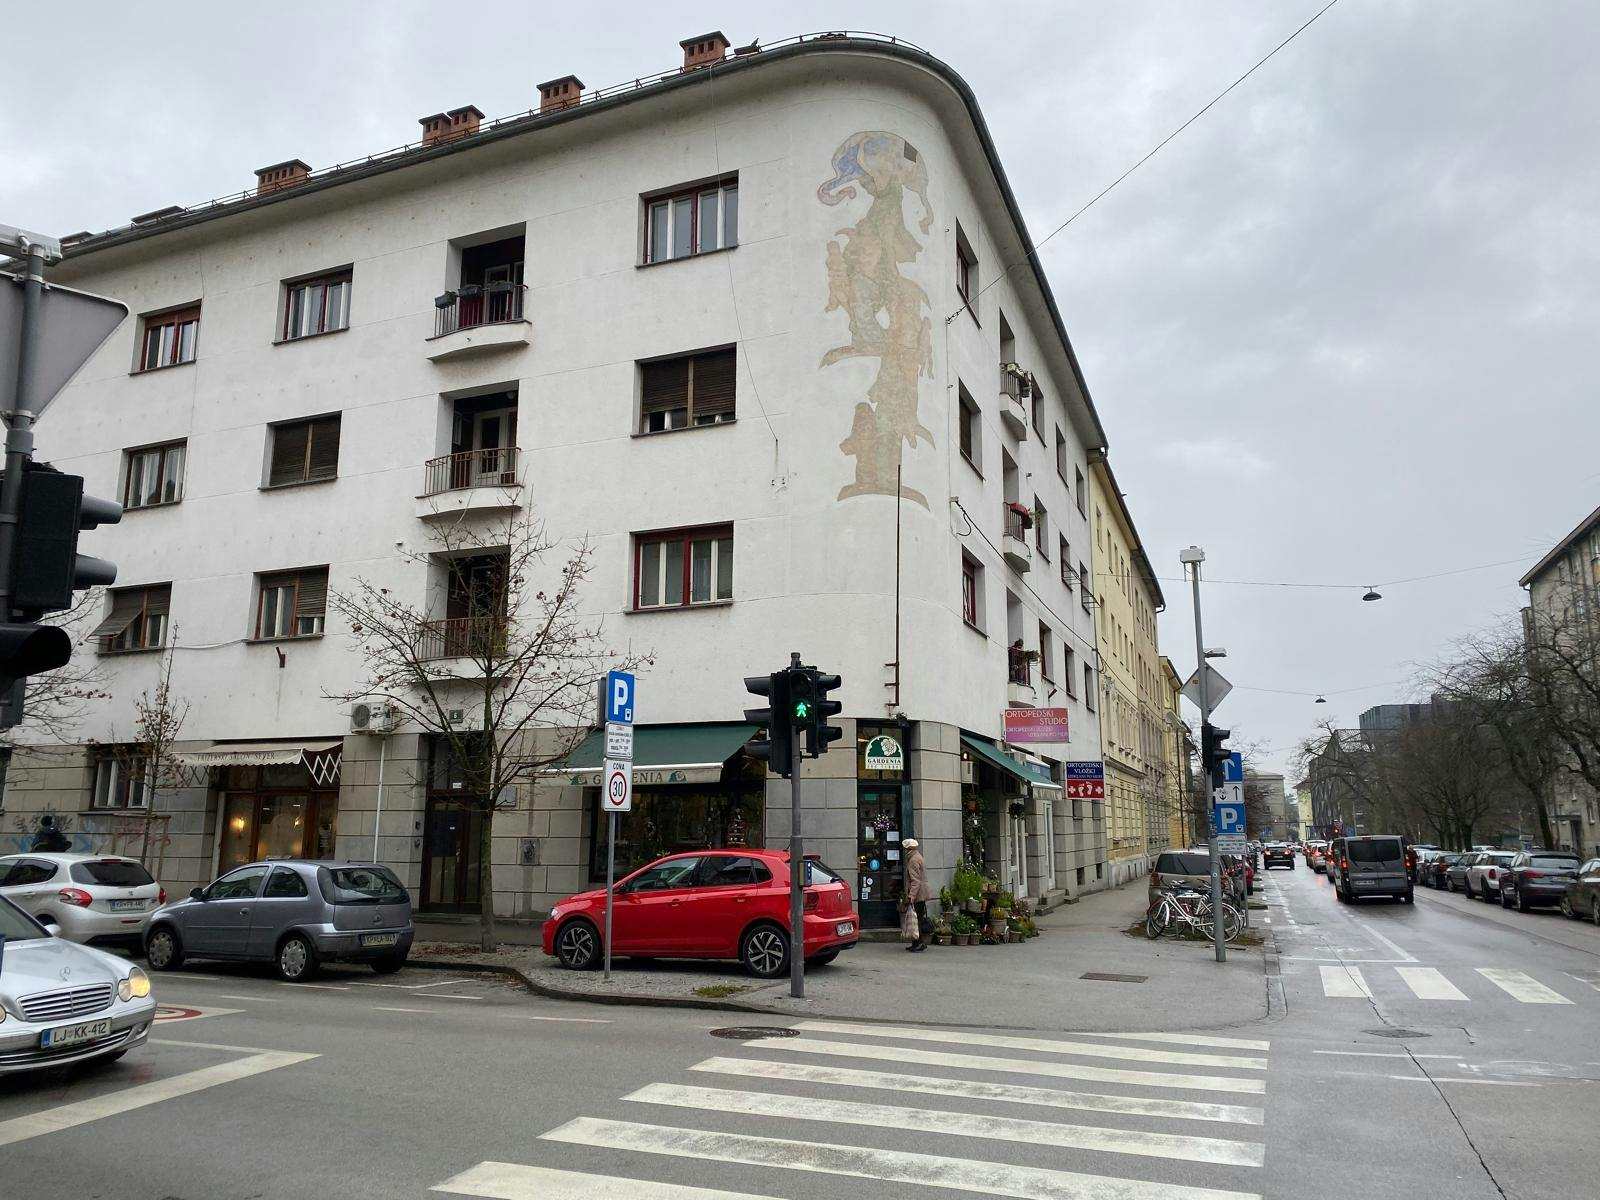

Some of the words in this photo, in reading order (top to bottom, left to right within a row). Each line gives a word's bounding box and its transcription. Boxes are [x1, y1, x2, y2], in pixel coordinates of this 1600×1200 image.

[613, 678, 628, 715] P
[1005, 709, 1054, 718] ORTOPEDSKI
[1039, 717, 1068, 725] STUDIO
[612, 762, 625, 770] CONA
[592, 772, 664, 785] GENIA
[612, 781, 623, 797] 30
[1220, 807, 1238, 830] P
[53, 1029, 67, 1043] LJ
[73, 1022, 107, 1039] KK-412
